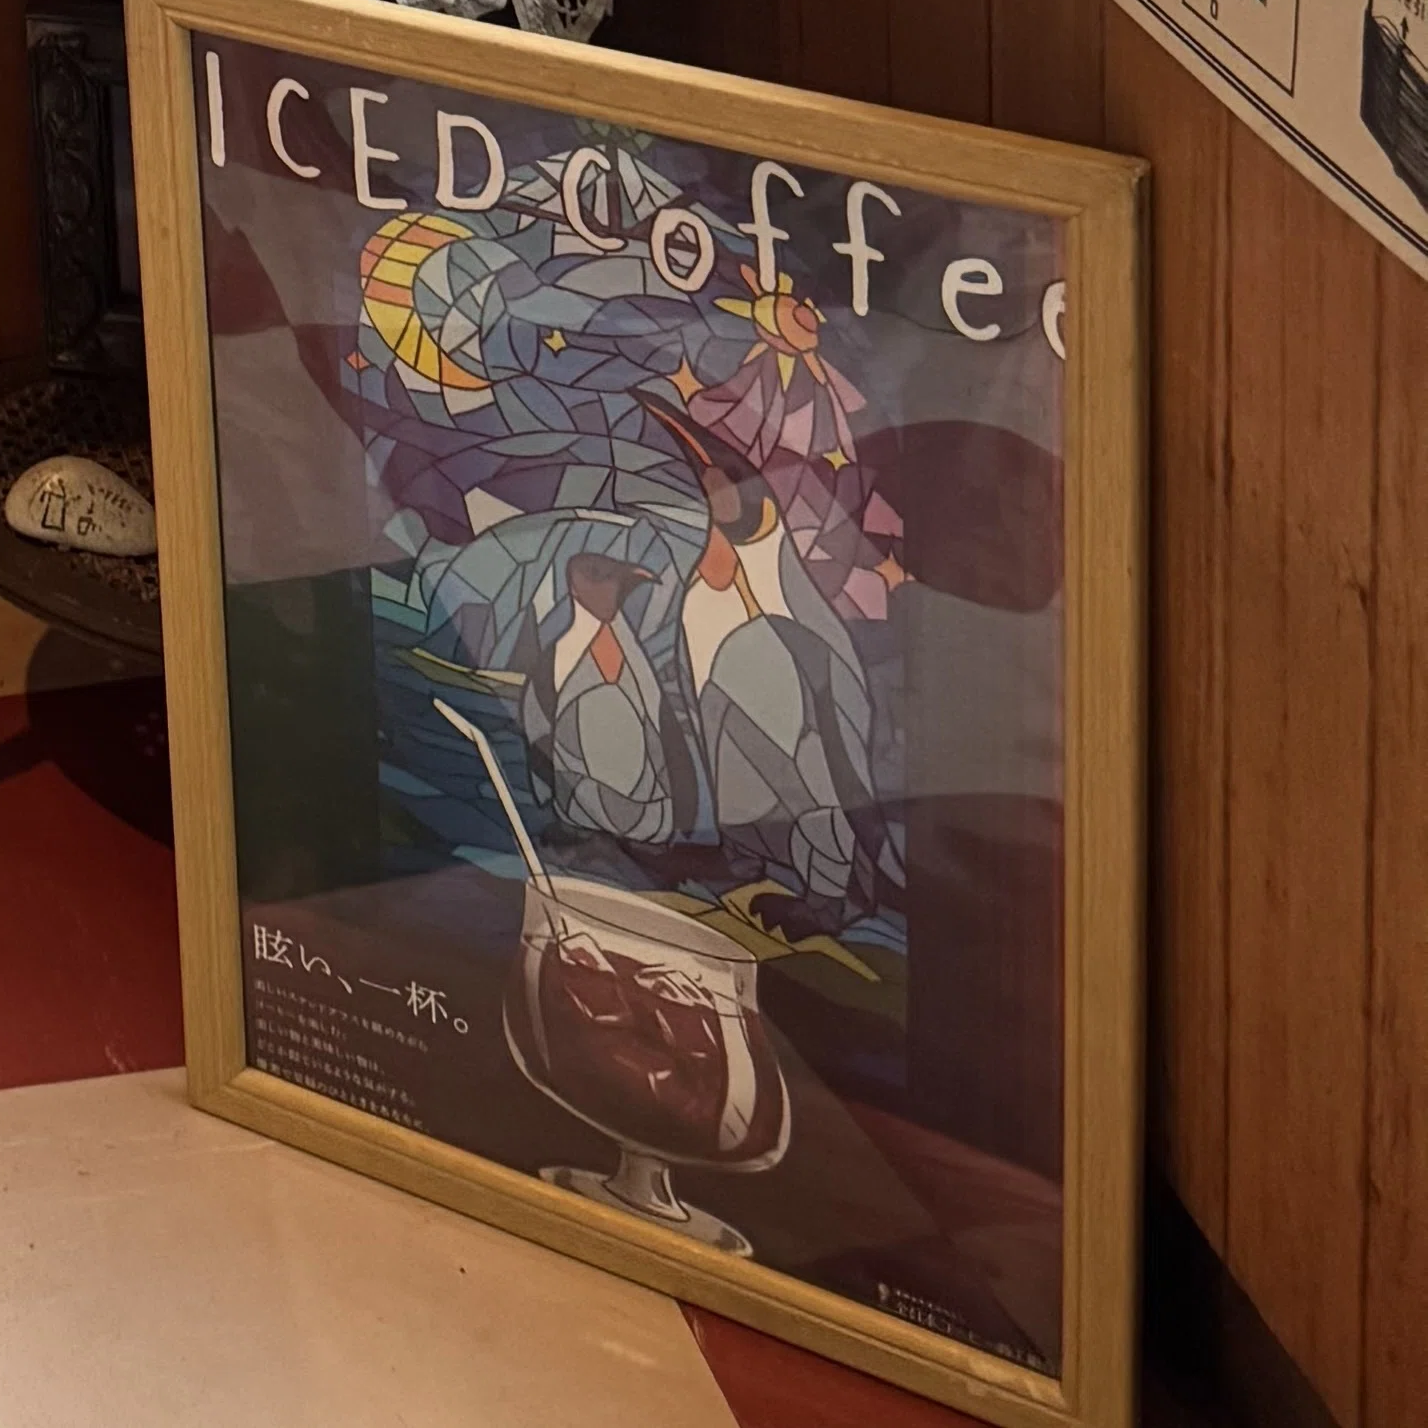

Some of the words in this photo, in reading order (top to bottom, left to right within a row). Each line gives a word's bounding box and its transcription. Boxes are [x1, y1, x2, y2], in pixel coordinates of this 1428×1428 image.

[205, 51, 509, 212] ICED
[253, 924, 469, 1034] 眩い、一杯。
